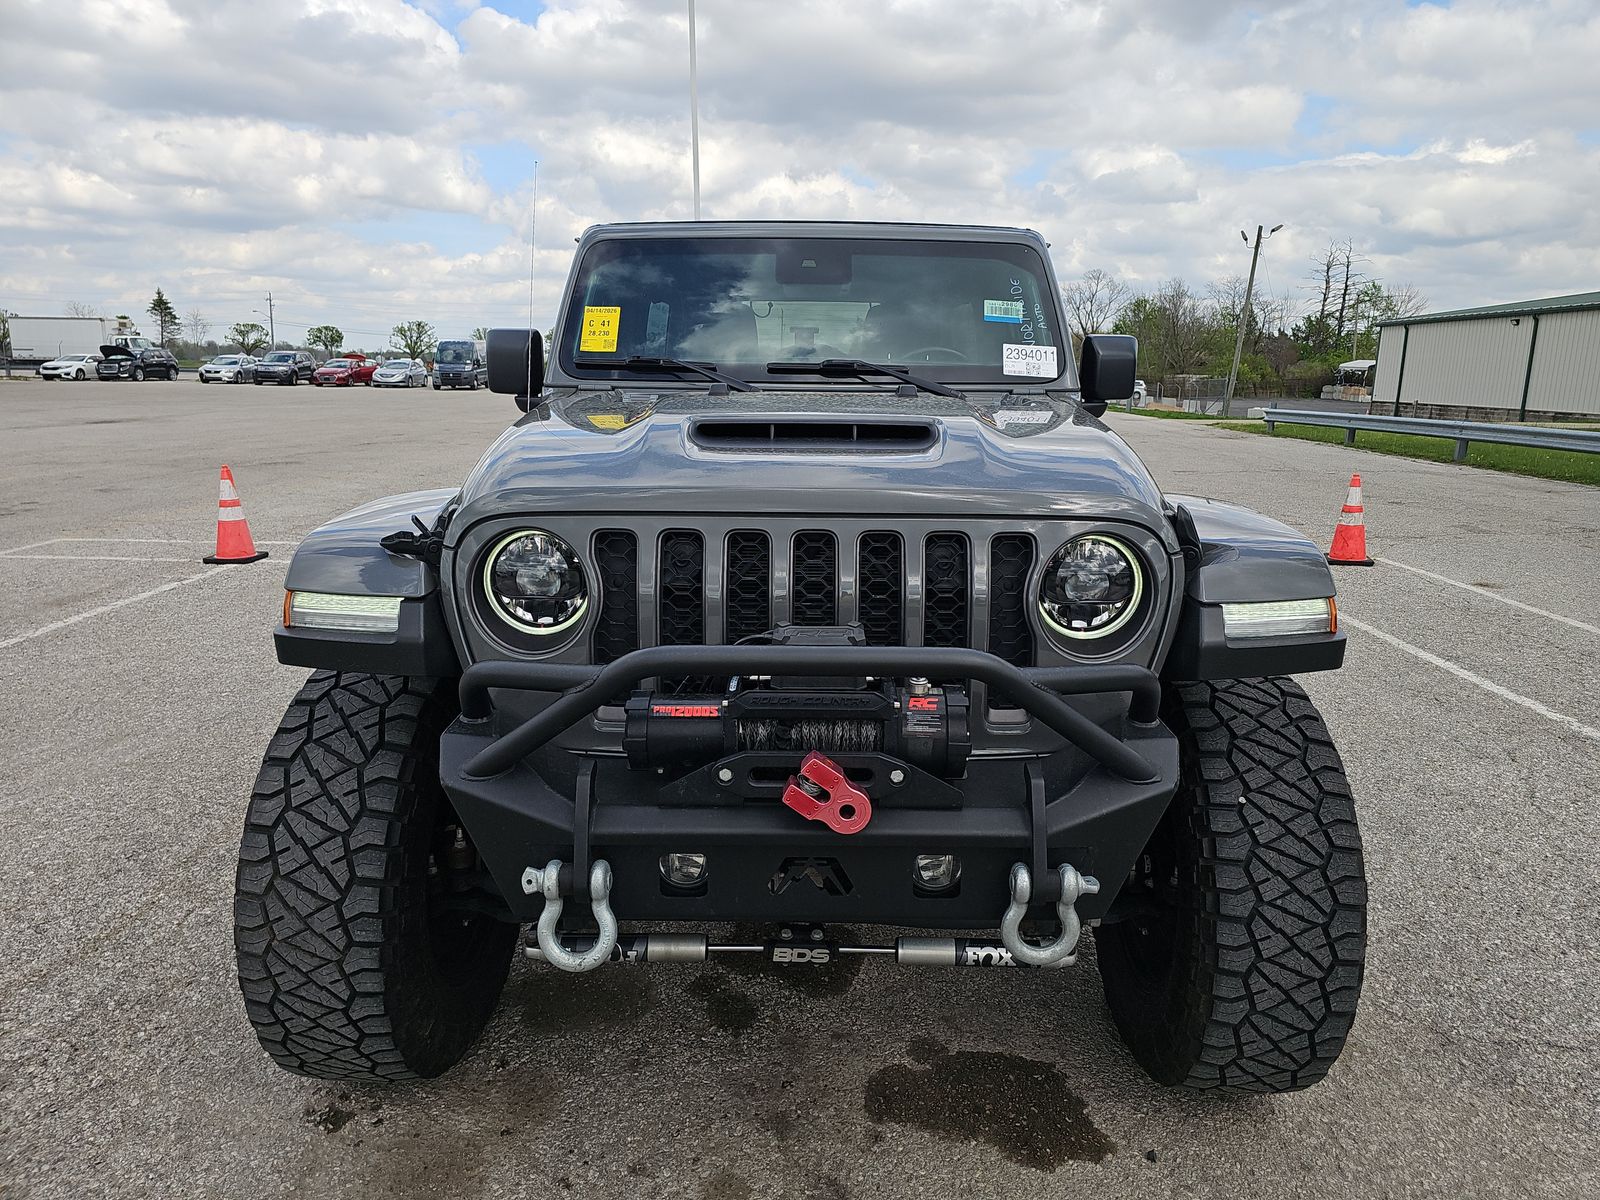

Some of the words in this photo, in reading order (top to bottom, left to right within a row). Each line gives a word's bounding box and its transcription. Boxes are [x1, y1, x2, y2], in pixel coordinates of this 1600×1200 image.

[1034, 303, 1048, 329] AUTO
[589, 320, 595, 328] C
[600, 320, 610, 328] 41
[1006, 347, 1055, 362] 2394011
[908, 697, 939, 708] RC
[772, 947, 830, 963] BDS
[965, 946, 1017, 966] FOX
